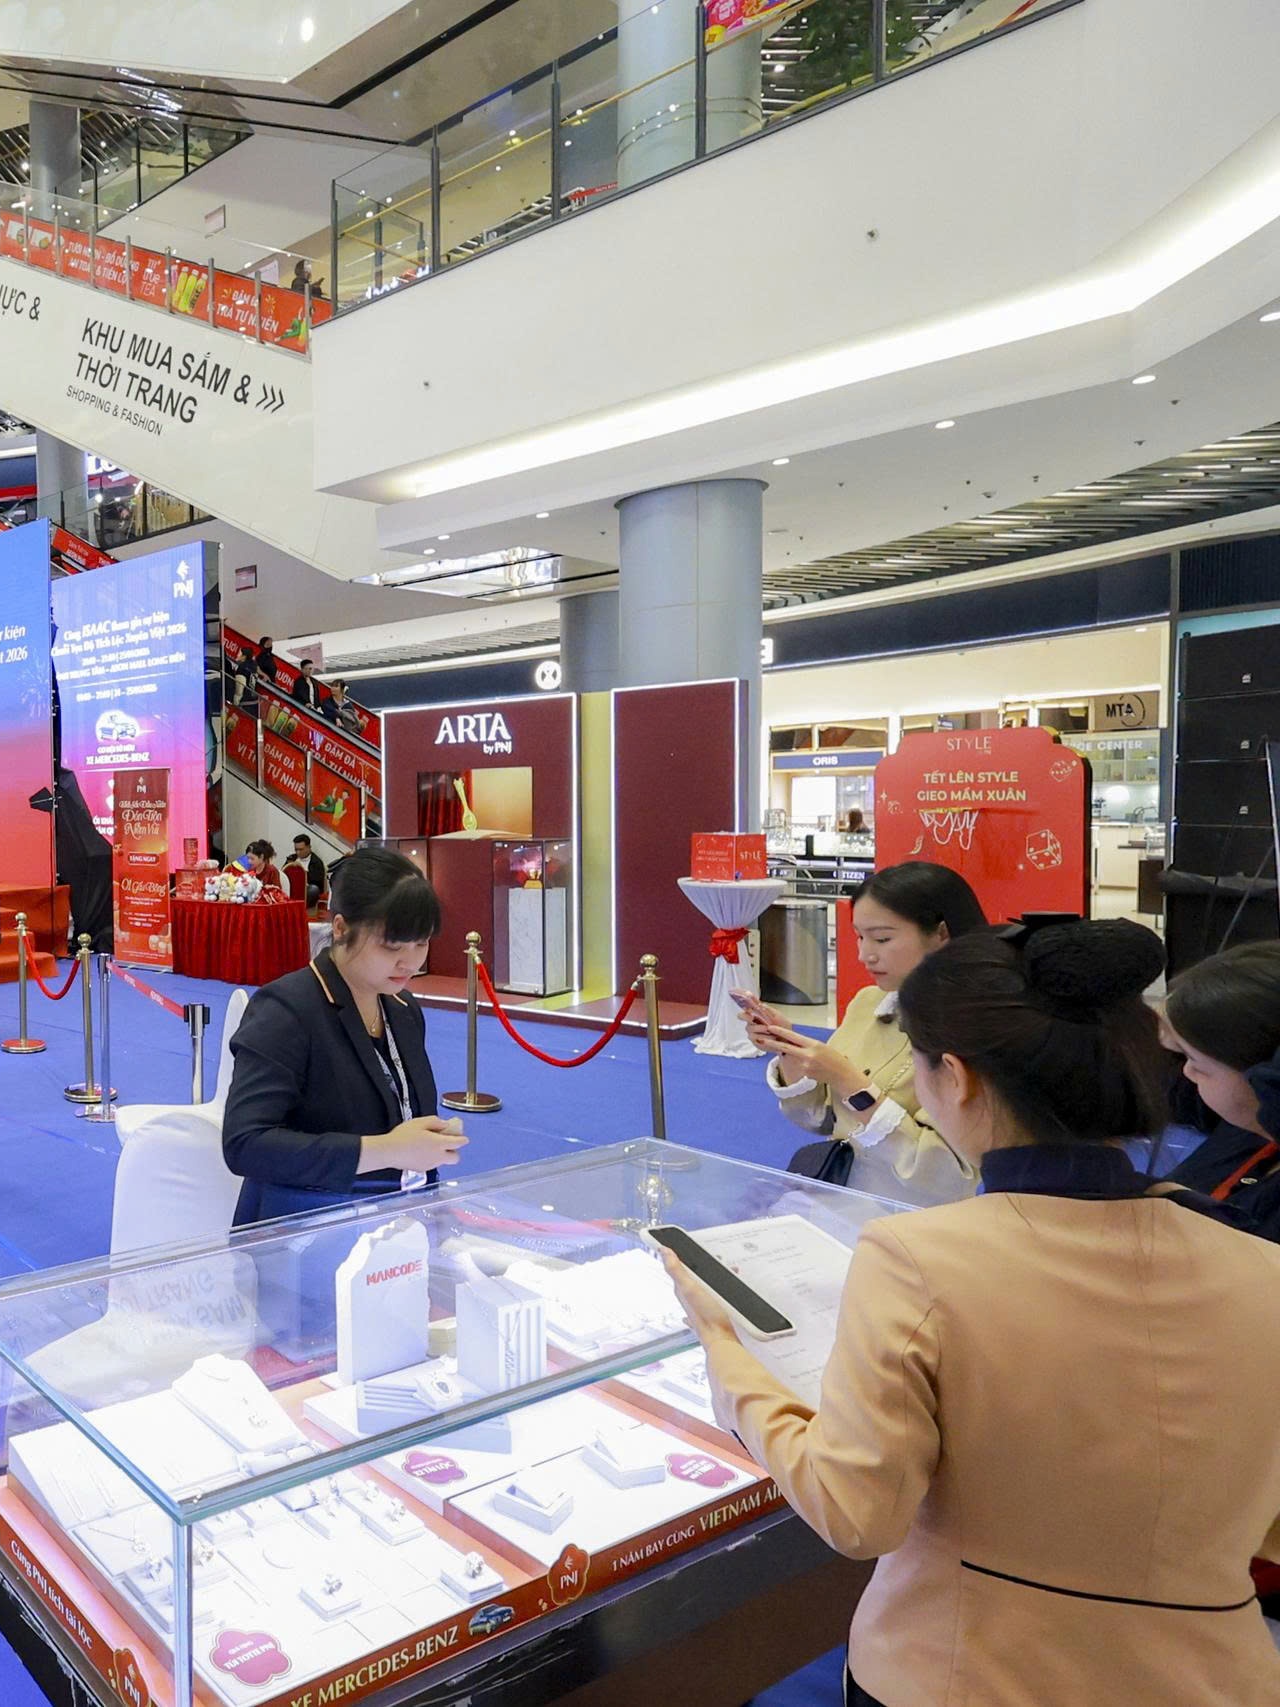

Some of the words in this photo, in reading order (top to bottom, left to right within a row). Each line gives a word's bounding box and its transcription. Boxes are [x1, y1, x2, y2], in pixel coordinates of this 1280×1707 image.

[140, 282, 156, 296] TEA
[29, 297, 41, 321] &
[81, 317, 125, 353] KHU
[127, 334, 173, 374] MUA
[178, 351, 231, 395] SẮM
[233, 374, 252, 405] &
[76, 353, 122, 392] THỜI
[125, 372, 198, 423] TRANG
[66, 385, 111, 413] SHOPPING
[112, 404, 119, 417] &
[120, 408, 163, 436] FASHION
[173, 579, 194, 599] PNJ
[4, 625, 26, 640] kiện
[82, 620, 111, 638] ISAAC
[5, 647, 28, 664] 2026
[434, 712, 512, 745] ARTA
[483, 743, 494, 755] by
[494, 741, 512, 754] PNJ
[946, 735, 992, 751] STYLE
[1097, 740, 1143, 751] CENTER
[812, 756, 838, 766] ORIS
[281, 772, 306, 798] NHIÊ
[923, 769, 946, 784] TẾT
[949, 769, 974, 784] LÊN
[977, 771, 1019, 783] STYLE
[917, 790, 947, 801] GIEO
[986, 788, 1027, 801] XUÂN
[366, 1260, 422, 1286] MANCODE
[612, 1559, 618, 1571] 1
[619, 1549, 644, 1568] NĂM
[646, 1540, 666, 1556] BAY
[665, 1524, 696, 1547] CÙNG
[699, 1491, 761, 1531] VIETNAM
[560, 1571, 578, 1589] PNJ
[11, 1540, 32, 1577] Cùng
[33, 1565, 48, 1594] PNJ
[48, 1587, 64, 1614] tích
[65, 1607, 76, 1630] tài
[77, 1621, 93, 1649] lộc
[318, 1625, 460, 1706] MERCEDES-BENZ
[124, 1676, 141, 1704] PNJ
